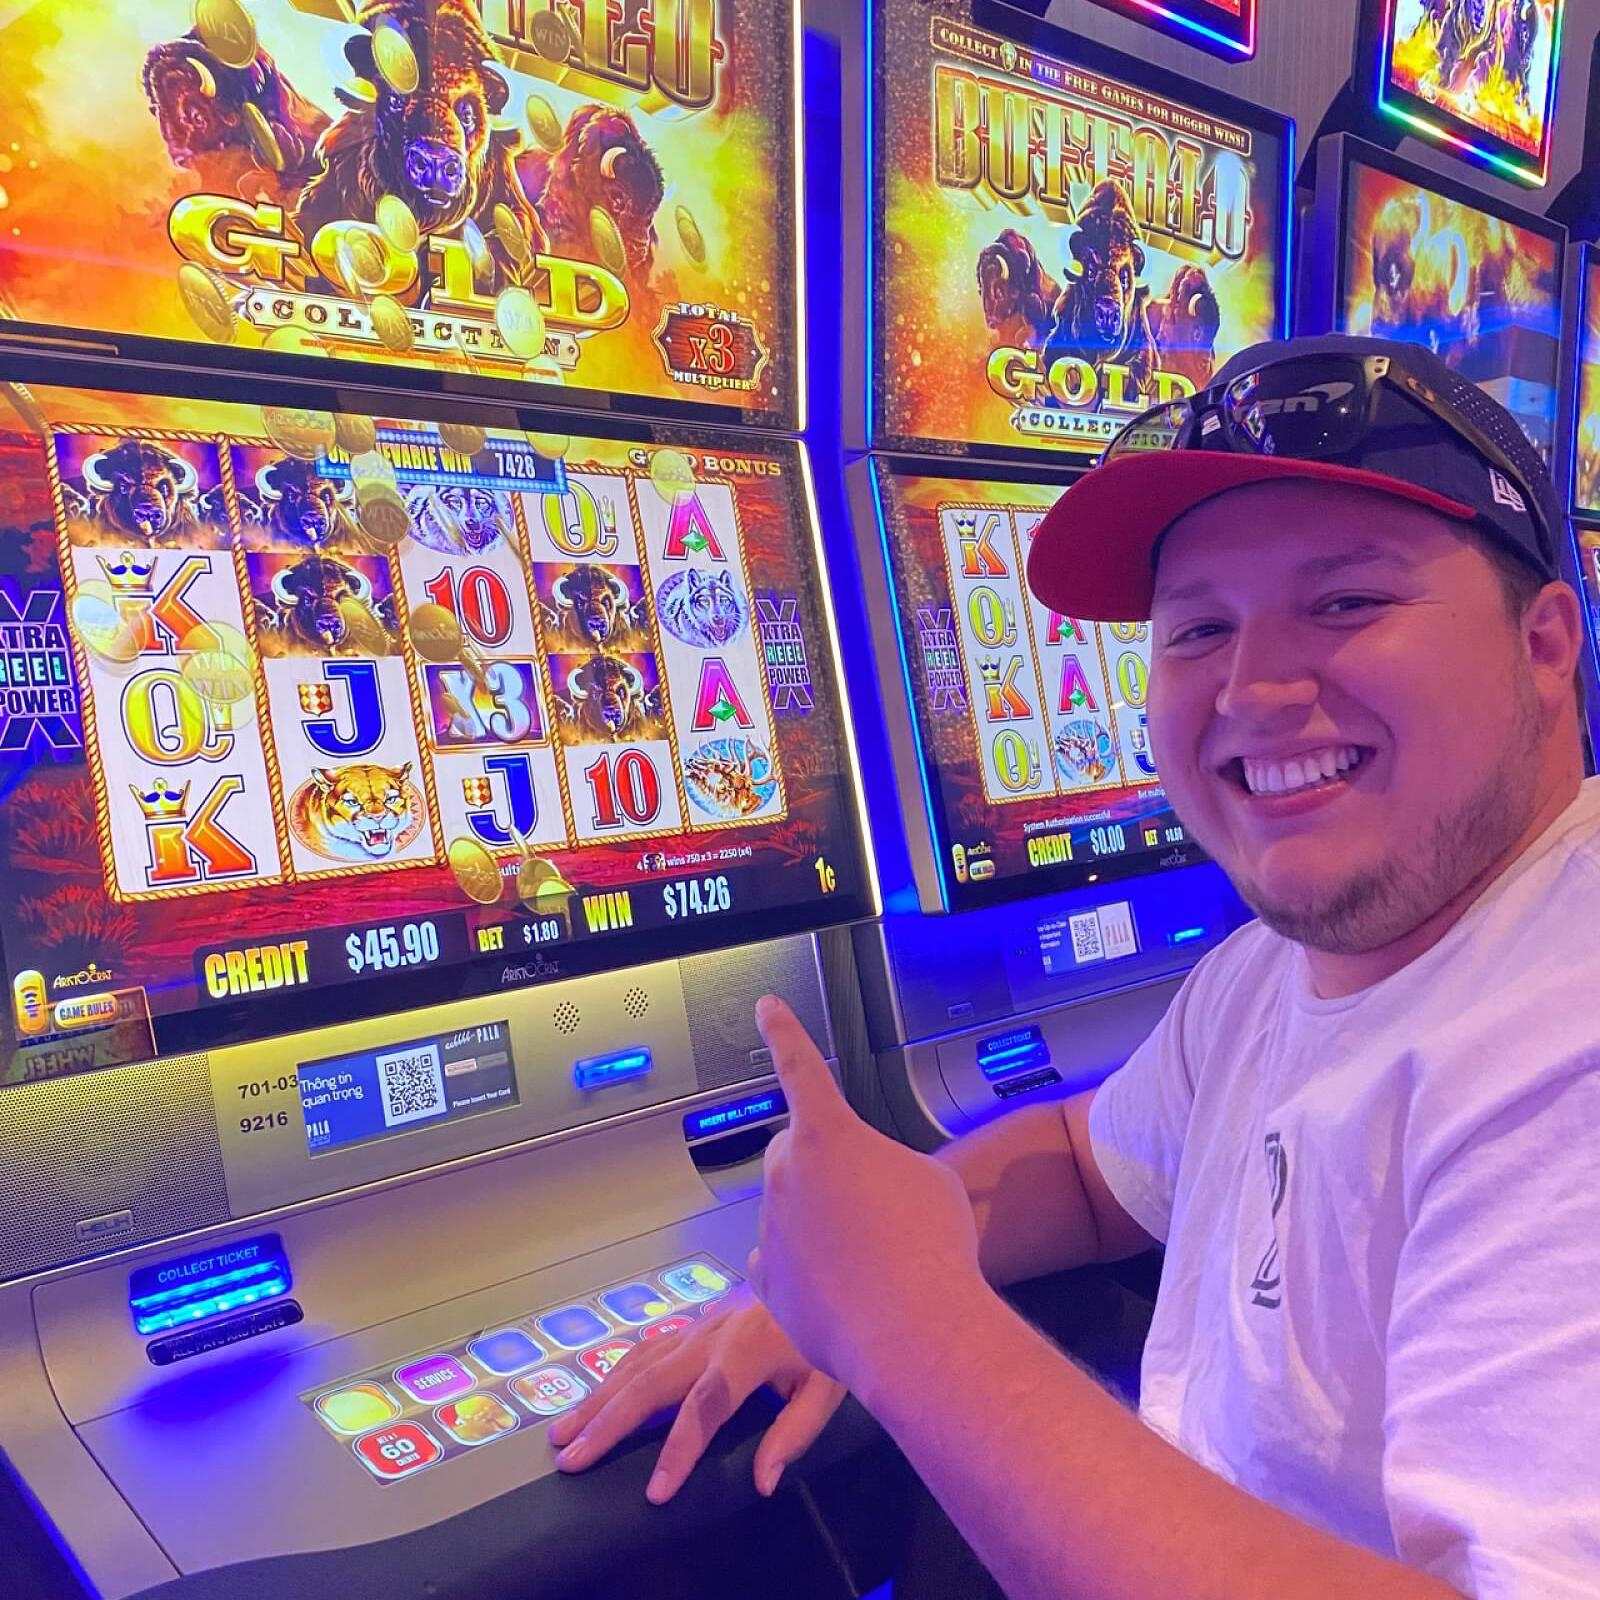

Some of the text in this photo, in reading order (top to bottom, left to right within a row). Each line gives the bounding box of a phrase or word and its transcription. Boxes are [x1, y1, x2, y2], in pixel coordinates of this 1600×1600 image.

[940, 28, 1246, 148] COLLECT IN THE FREE GAMES FOR BIGGER WINS!
[934, 65, 1251, 260] BUFFALO
[168, 193, 630, 330] GOLD
[679, 303, 737, 322] TOTAL
[673, 371, 753, 391] MULTIPLIER
[986, 345, 1197, 413] GOLD
[440, 447, 473, 475] WIN
[496, 452, 537, 480] 7428
[703, 456, 781, 476] BONUS
[541, 478, 619, 558] Q
[663, 490, 727, 562] A
[960, 514, 1009, 579] K
[113, 555, 222, 656] K
[425, 565, 512, 648] 10
[968, 586, 1017, 648] Q
[763, 624, 800, 640] XTRA
[766, 643, 804, 664] REEL
[926, 650, 957, 668] REEL
[691, 657, 755, 732] A
[769, 667, 810, 685] POWER
[929, 672, 962, 687] POWER
[986, 655, 1032, 722] K
[1058, 654, 1099, 715] A
[120, 667, 236, 767] Q
[303, 660, 386, 758] J
[993, 729, 1041, 791] Q
[466, 752, 539, 845] J
[585, 747, 661, 830] 10
[145, 774, 257, 887] K
[1023, 822, 1045, 834] System
[1045, 815, 1083, 829] Authorization
[667, 857, 684, 867] wins
[686, 852, 700, 864] 750
[719, 849, 737, 860] 2250
[1027, 833, 1074, 868] CREDIT
[1090, 825, 1126, 856] $0.00
[1144, 828, 1159, 847] BET
[205, 876, 731, 998] CREDIT $45.90 BET $1.80 WIN $74.26
[60, 1006, 85, 1021] GAME
[87, 1001, 112, 1016] RULES
[476, 1024, 501, 1043] PALA
[238, 1075, 298, 1099] 701-03
[300, 1071, 353, 1093] Thông tin
[303, 1093, 331, 1109] quan
[239, 1111, 289, 1133] 9216
[306, 1120, 330, 1138] PALA
[699, 1112, 727, 1129] INSERT
[157, 1246, 260, 1284] COLLECT TICKET
[413, 1366, 458, 1391] SERVICE
[380, 1438, 415, 1459] 60
